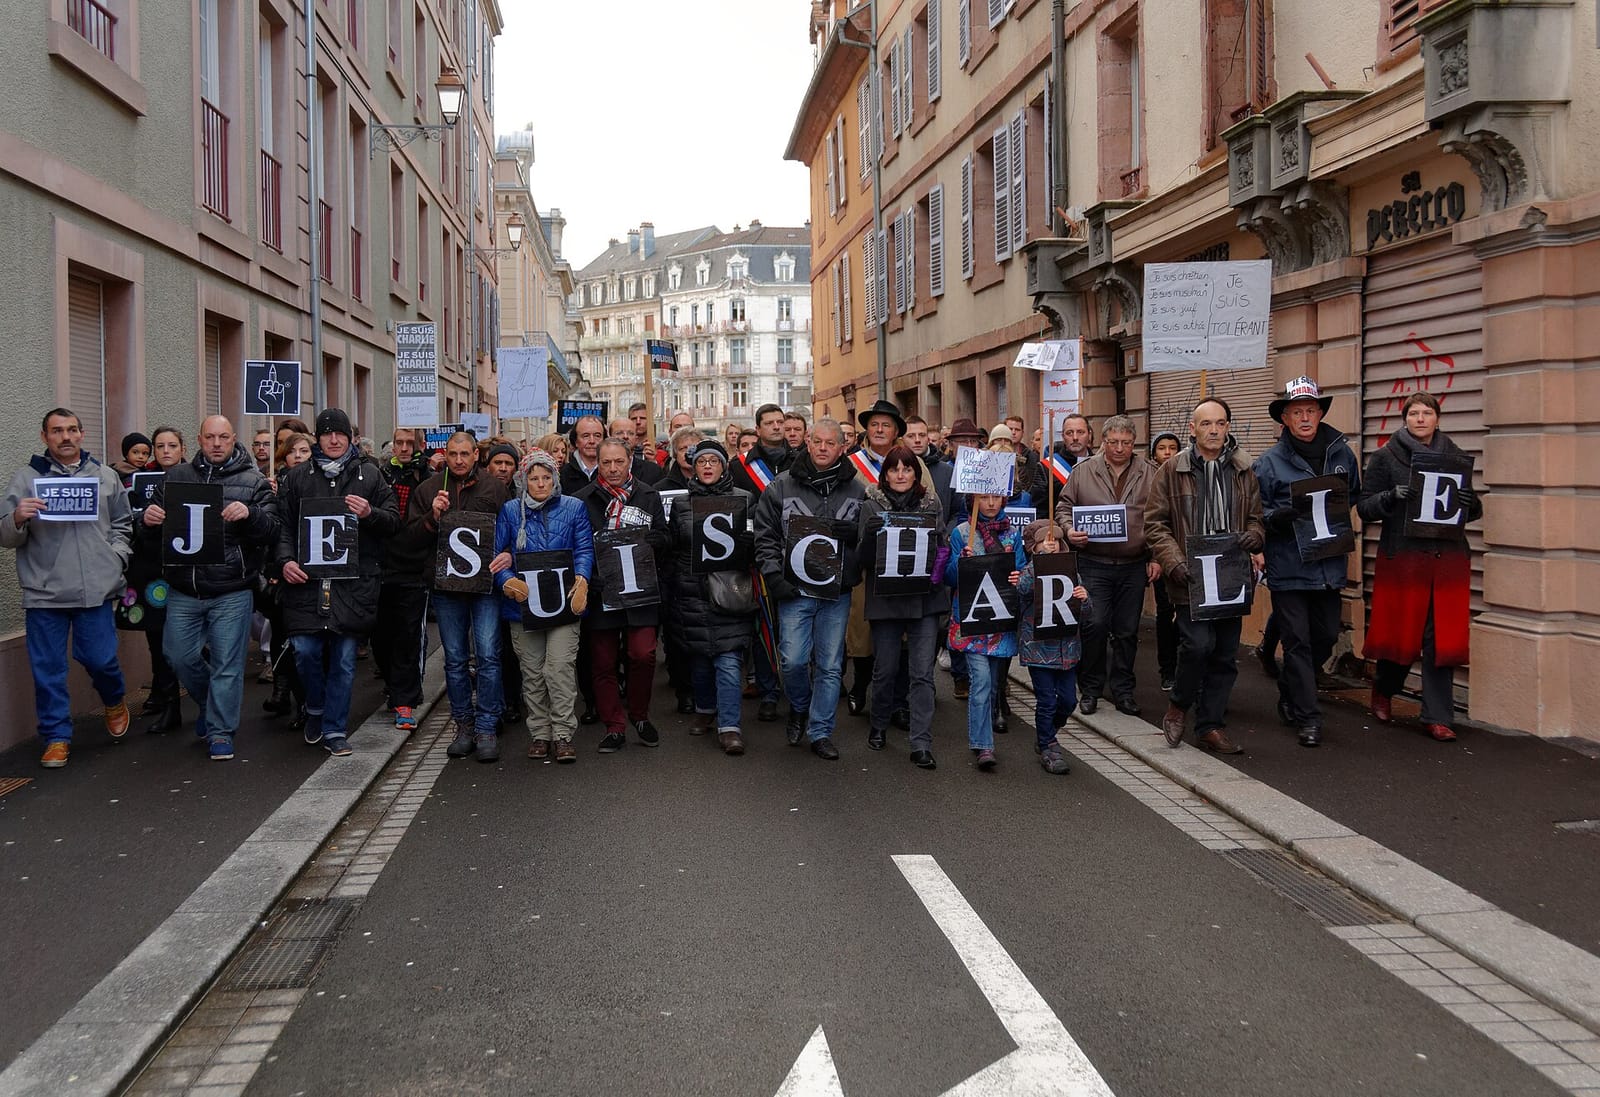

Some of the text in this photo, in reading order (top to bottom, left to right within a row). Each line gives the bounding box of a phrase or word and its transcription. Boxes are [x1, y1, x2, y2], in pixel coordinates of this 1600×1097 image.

[1227, 273, 1243, 288] Je
[397, 334, 435, 344] CHARLIE
[410, 326, 434, 334] SUIS
[1211, 316, 1267, 336] TOLÉRANT
[397, 359, 436, 369] CHARLIE
[398, 351, 435, 359] JE SUIS
[398, 375, 435, 383] JE SUIS
[398, 383, 436, 393] CHARLIE
[576, 402, 603, 410] SUIS
[41, 488, 93, 498] JE SUIS
[1306, 490, 1338, 540] I
[1414, 471, 1463, 524] E
[172, 503, 211, 555] J
[303, 515, 350, 566] E
[702, 513, 735, 562] S
[1078, 513, 1121, 523] JE SUIS
[446, 526, 482, 578] S
[612, 543, 645, 595] I
[790, 534, 838, 586] C
[878, 527, 933, 578] H
[519, 567, 569, 618] U
[961, 571, 1015, 623] A
[1036, 574, 1078, 628] R
[1194, 554, 1246, 608] L
